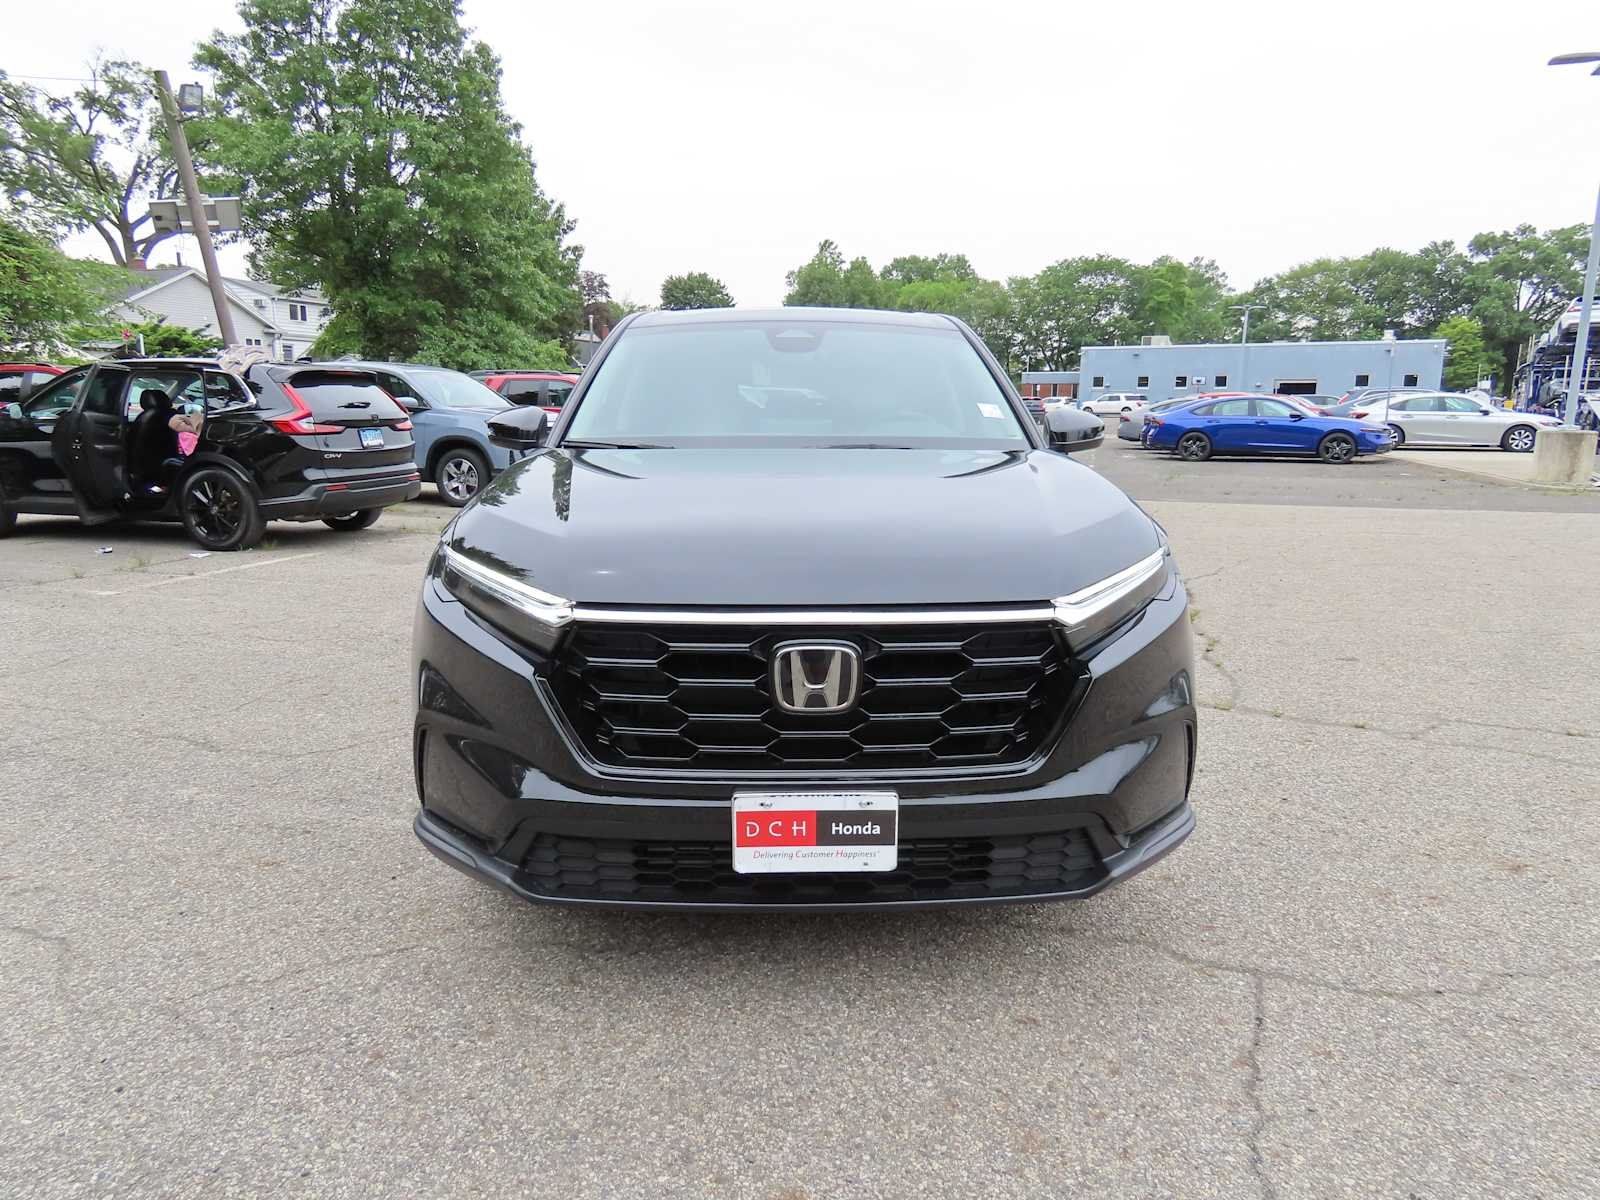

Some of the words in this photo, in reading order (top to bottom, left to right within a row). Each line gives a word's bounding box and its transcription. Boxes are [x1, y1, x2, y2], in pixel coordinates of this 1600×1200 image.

[831, 821, 881, 835] Honda
[753, 850, 793, 860] Delivering
[795, 849, 834, 859] Customer
[835, 849, 877, 859] Happiness
